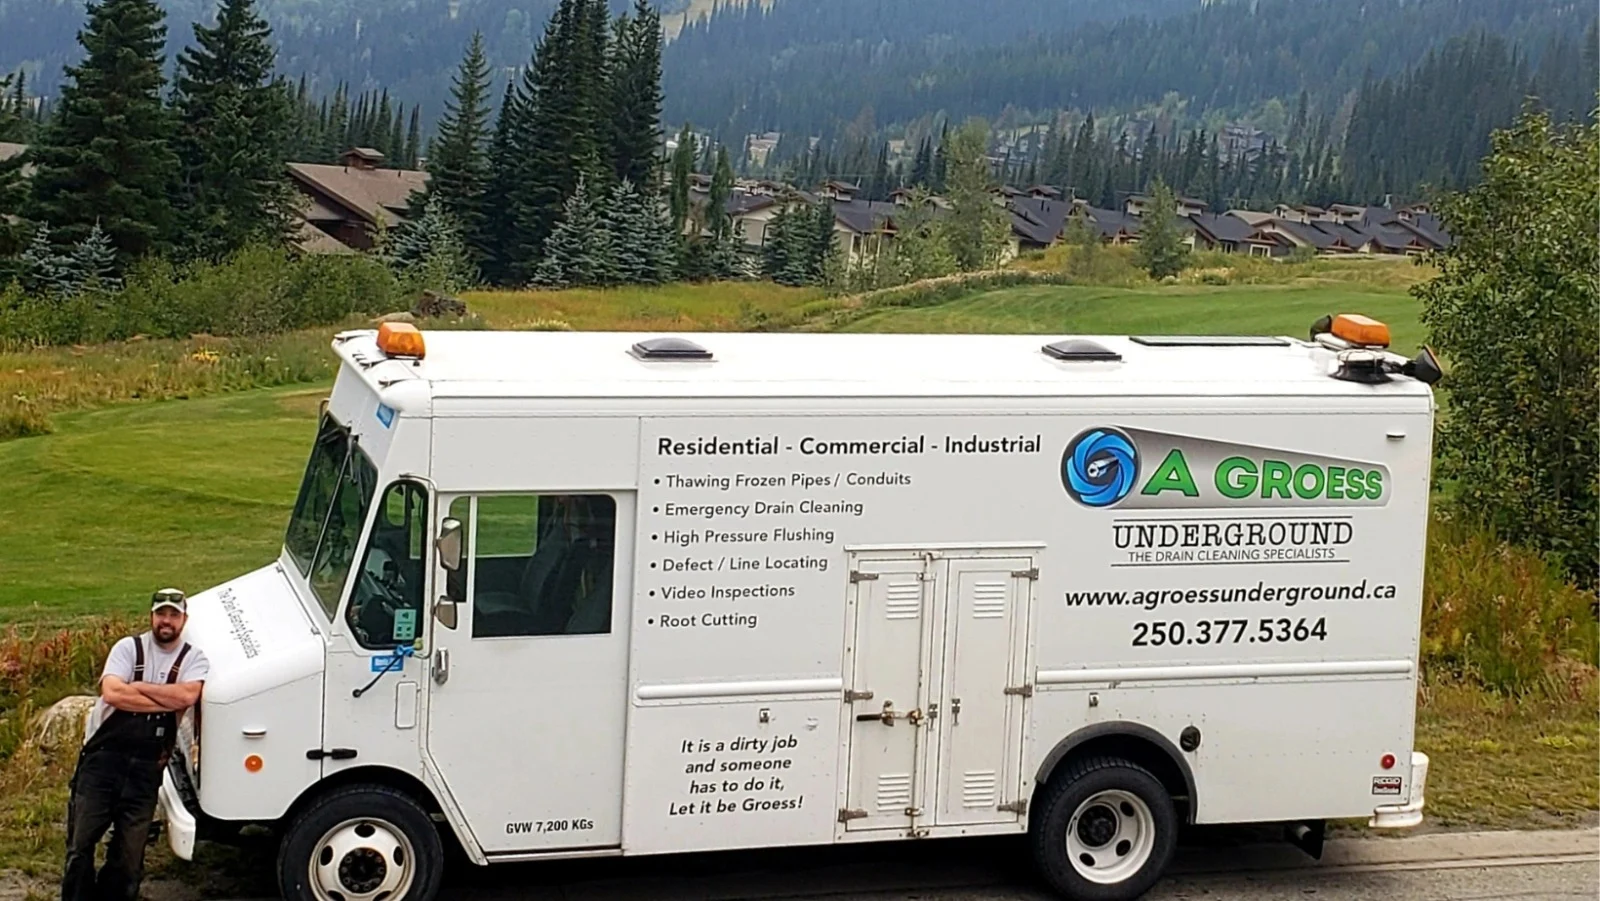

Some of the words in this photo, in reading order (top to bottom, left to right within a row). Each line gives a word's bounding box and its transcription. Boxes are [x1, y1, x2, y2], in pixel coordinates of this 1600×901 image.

[659, 436, 778, 455] Residential
[800, 435, 924, 454] Commercial
[946, 435, 1040, 453] Industrial
[666, 475, 729, 490] Thawing
[736, 474, 785, 486] Frozen
[792, 474, 830, 489] Pipes
[847, 472, 910, 485] Conduits
[1141, 449, 1199, 498] A
[1215, 456, 1382, 499] GROESS
[666, 503, 749, 518] Emergency
[755, 501, 793, 514] Drain
[800, 500, 863, 516] Cleaning
[665, 530, 699, 547] High
[705, 530, 767, 542] Pressure
[774, 528, 833, 544] Flushing
[1113, 521, 1353, 549] UNDERGROUND
[663, 558, 712, 571] Defect
[730, 558, 759, 570] Line
[766, 556, 827, 571] Locating
[1127, 551, 1152, 562] THE
[1155, 551, 1194, 562] DRAIN
[1197, 549, 1260, 561] CLEANING
[1263, 548, 1337, 560] SPECIALISTS
[662, 586, 705, 599] Video
[712, 585, 794, 600] Inspections
[1066, 580, 1395, 610] www.agroessunderground.ca
[661, 615, 696, 627] Root
[702, 613, 756, 628] Cutting
[1132, 618, 1327, 646] 250.377.5364
[682, 740, 693, 752] It
[699, 739, 710, 752] is
[716, 742, 724, 751] a
[730, 737, 768, 753] dirty
[771, 735, 797, 753] job
[686, 759, 715, 773] and
[720, 760, 791, 771] someone
[690, 780, 716, 793] has
[723, 781, 738, 792] to
[744, 777, 764, 790] do
[770, 777, 784, 790] it,
[670, 803, 695, 815] Let
[700, 801, 711, 813] it
[717, 799, 736, 812] be
[743, 796, 803, 811] Groess!
[507, 823, 532, 833] GVW
[536, 821, 568, 833] 7,200
[572, 819, 593, 829] KGs
